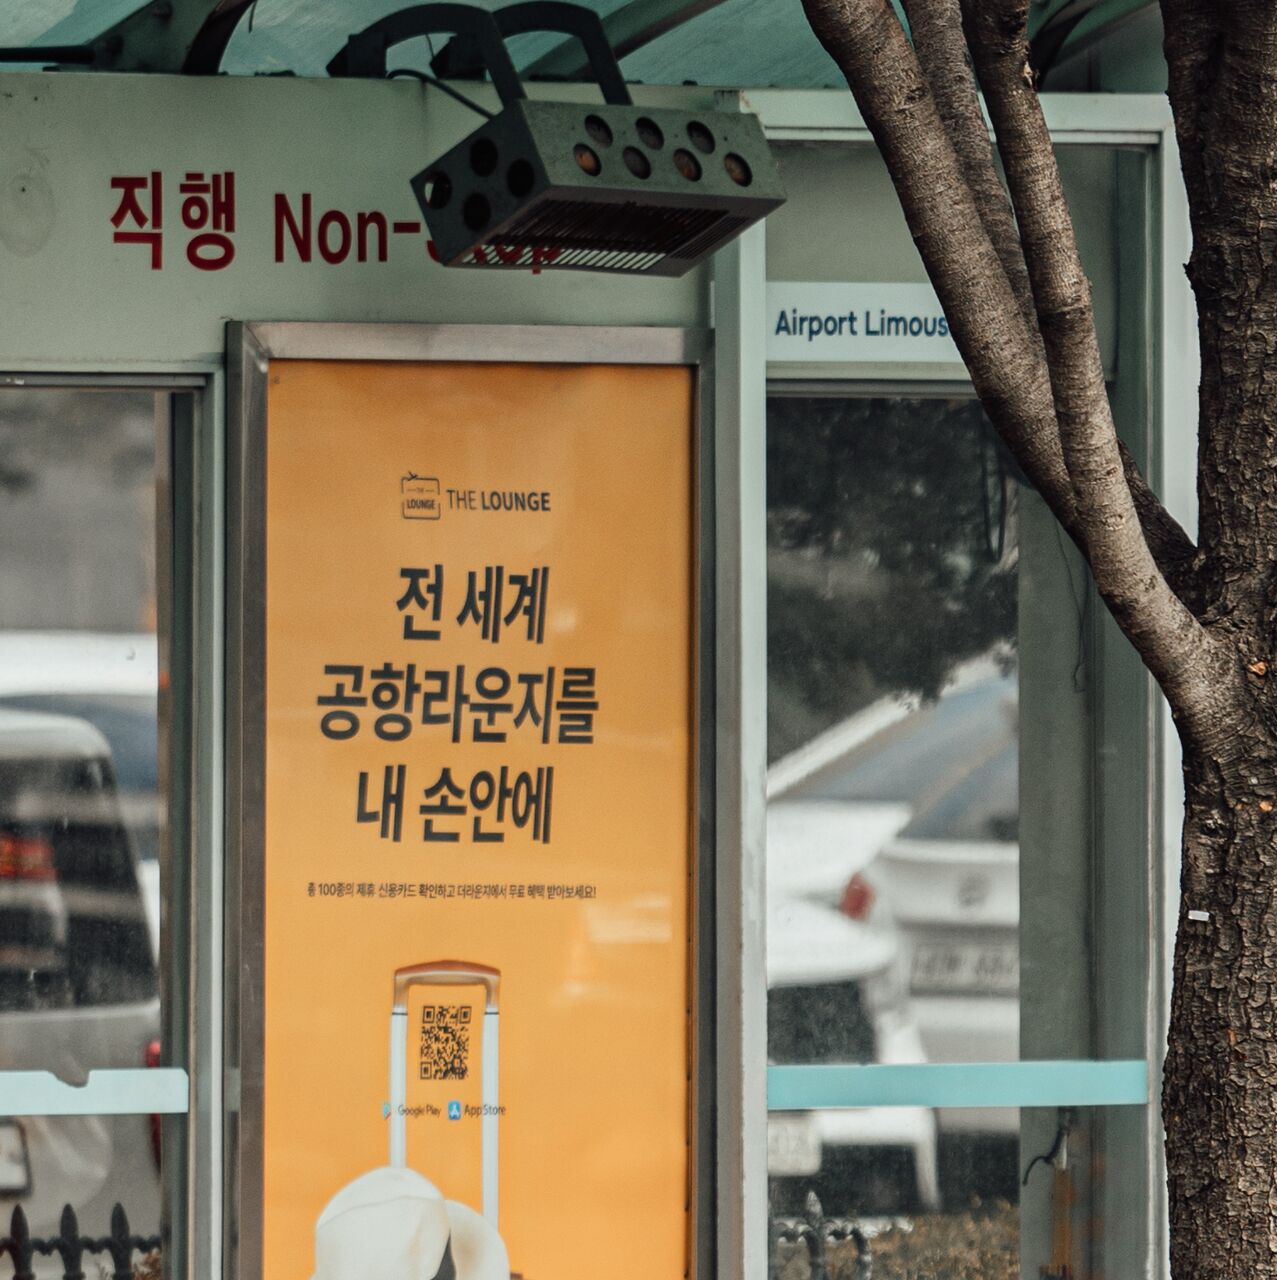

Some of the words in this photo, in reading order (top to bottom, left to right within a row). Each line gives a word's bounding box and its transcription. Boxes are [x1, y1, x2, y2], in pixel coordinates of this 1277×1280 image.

[109, 171, 236, 271] 직행
[775, 307, 858, 341] Airport
[865, 309, 950, 337] Limous
[406, 499, 436, 510] LOUNGE
[446, 489, 477, 510] THE
[481, 491, 551, 512] LOUNGE
[396, 564, 443, 641] 전
[456, 566, 550, 644] 세계
[317, 662, 599, 744] 공항라운지를
[357, 764, 406, 843] 내
[419, 766, 554, 845] 손안에
[379, 883, 417, 898] 신용카드
[418, 883, 456, 899] 확인하고
[398, 1104, 425, 1117] Google
[426, 1104, 442, 1118] Play
[464, 1104, 481, 1117] App
[484, 1104, 506, 1116] Store
